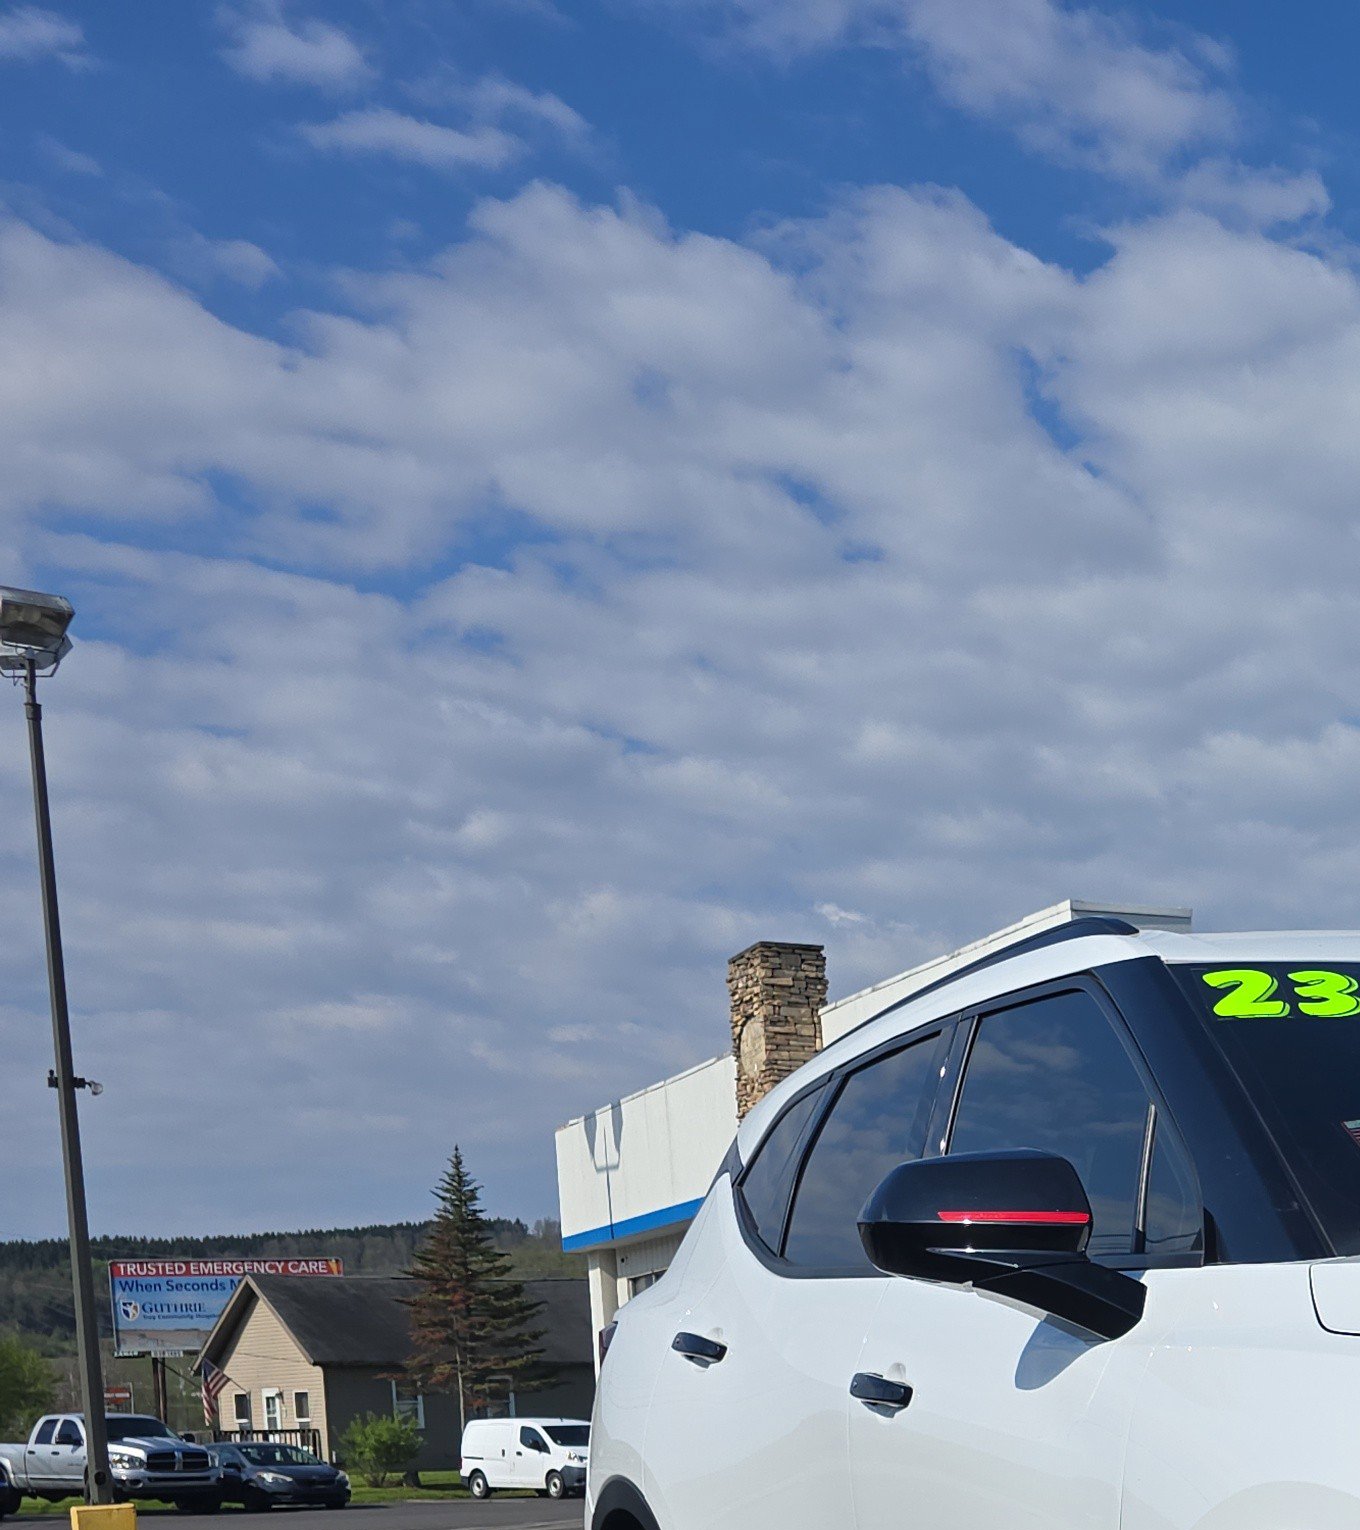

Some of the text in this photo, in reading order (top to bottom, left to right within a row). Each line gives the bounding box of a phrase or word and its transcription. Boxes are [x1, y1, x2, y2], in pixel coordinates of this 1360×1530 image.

[117, 1260, 328, 1276] TRUSTED EMERGENCY CARE
[119, 1280, 162, 1293] When
[166, 1279, 226, 1292] Seconds
[142, 1302, 206, 1314] GUTHRIE
